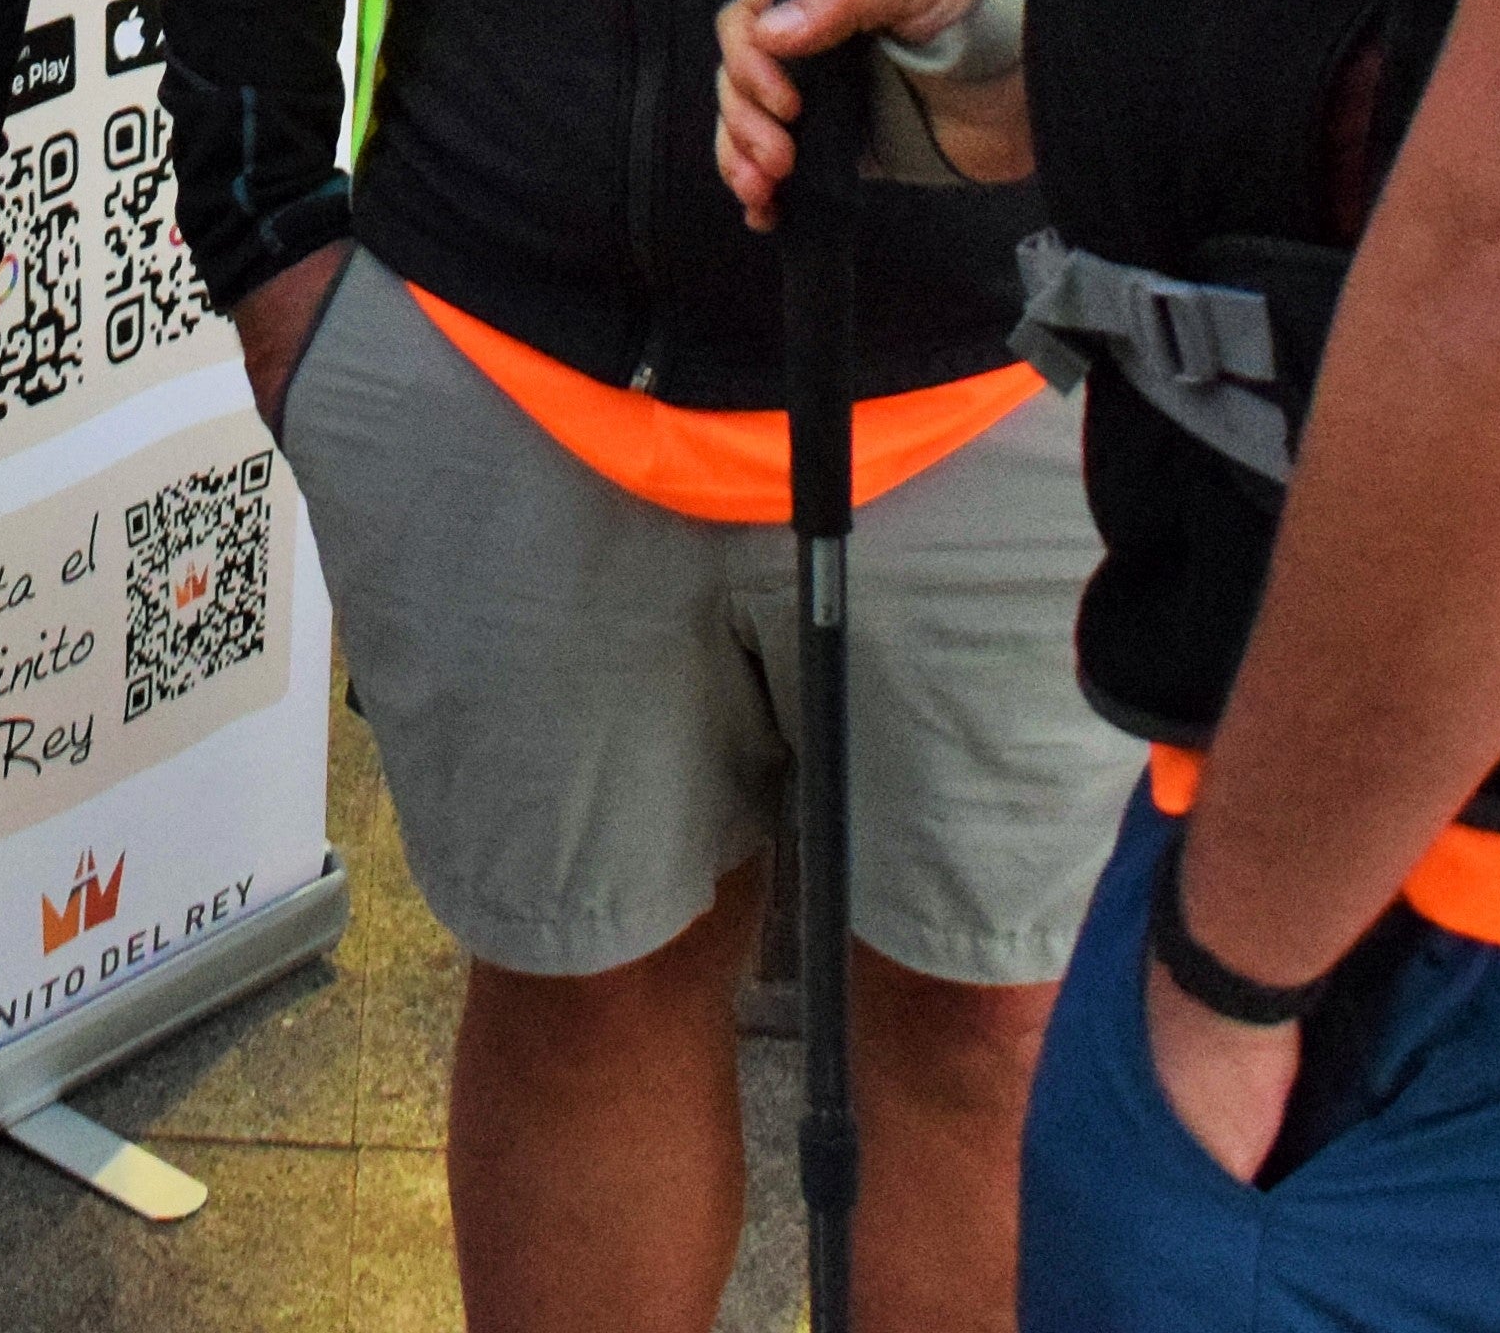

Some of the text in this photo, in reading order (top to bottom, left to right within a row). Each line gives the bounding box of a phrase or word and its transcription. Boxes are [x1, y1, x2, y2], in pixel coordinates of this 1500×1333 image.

[28, 54, 70, 89] Play
[61, 511, 99, 583] el
[101, 929, 171, 981] DEL
[185, 874, 256, 933] REY
